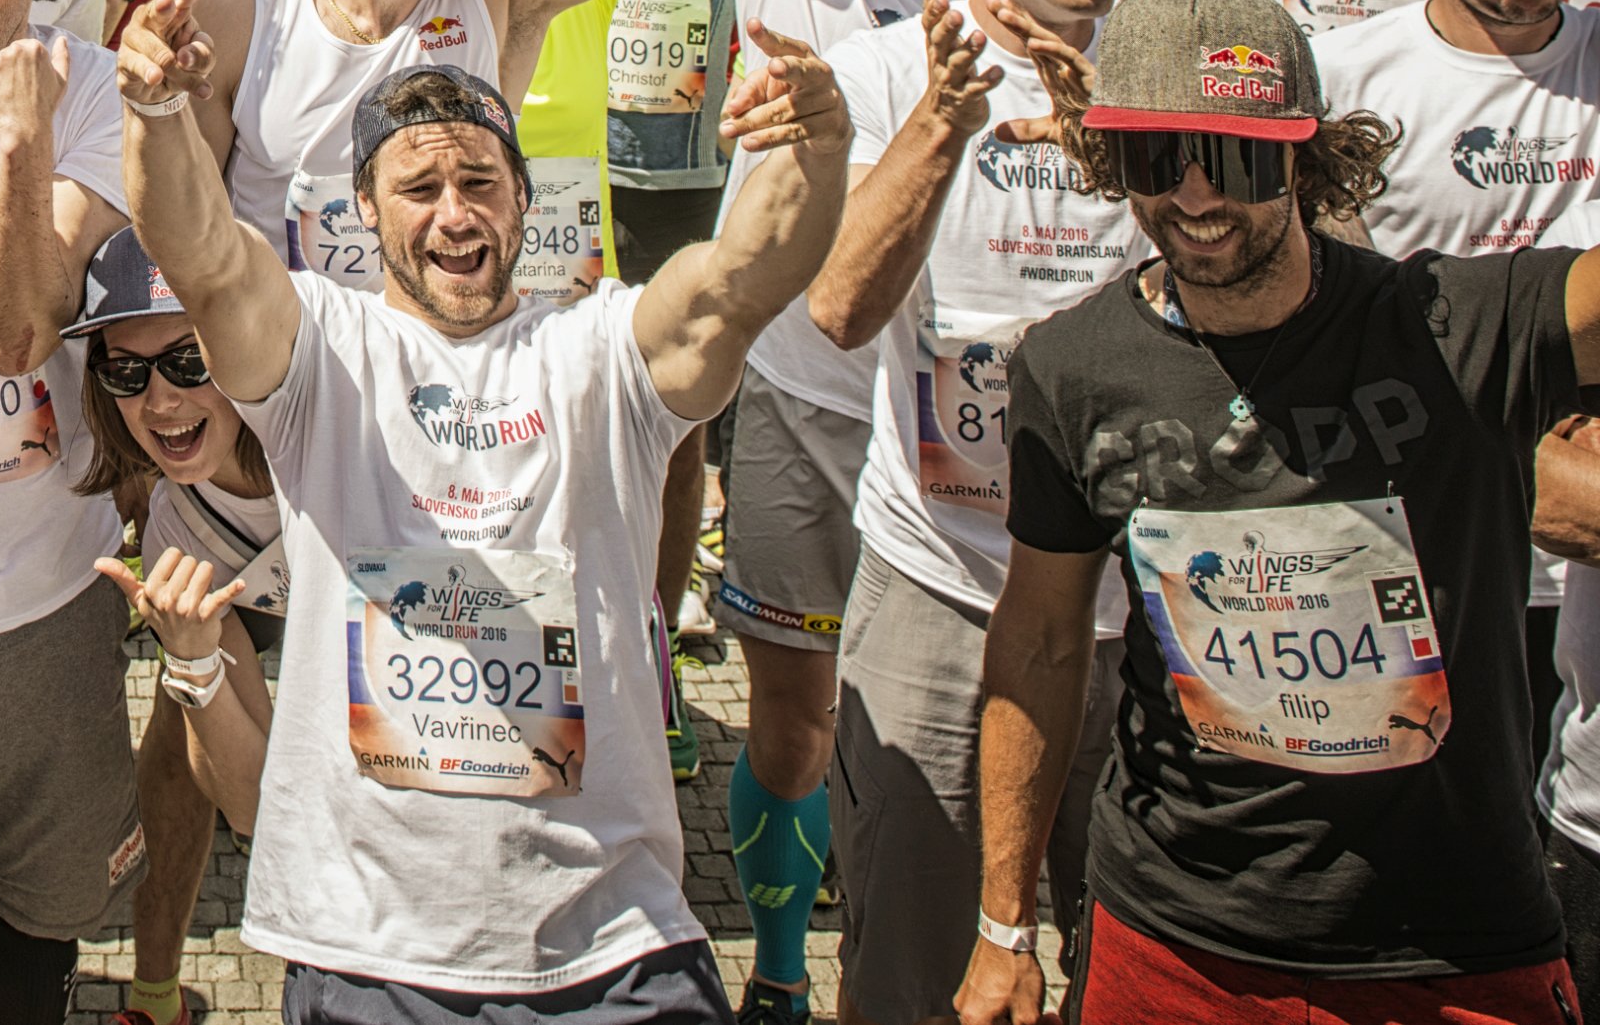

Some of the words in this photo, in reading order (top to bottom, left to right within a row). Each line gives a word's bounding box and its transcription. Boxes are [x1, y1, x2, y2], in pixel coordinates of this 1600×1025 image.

[623, 0, 666, 13] WINGS
[419, 36, 443, 52] Red
[444, 31, 467, 48] Bull
[610, 37, 685, 69] 0919
[609, 68, 668, 87] Christof
[1202, 74, 1247, 99] Red
[1247, 77, 1284, 104] Bull
[621, 93, 672, 104] BFGoodrich
[1497, 138, 1547, 152] WINGS
[1022, 225, 1033, 238] 8.
[1060, 227, 1089, 241] 2016
[1470, 233, 1531, 247] SLOVENSKO
[988, 238, 1053, 256] SLOVENSKO
[1056, 244, 1125, 259] BRATISLAVA
[1019, 266, 1094, 283] #WORLDRUN
[518, 286, 573, 297] BFGoodrich
[448, 484, 457, 500] 8.
[461, 487, 484, 505] MÁJ
[487, 488, 512, 504] 2016
[929, 482, 1002, 500] GARMIN
[412, 494, 478, 520] SLOVENSKO
[440, 524, 512, 542] #WORLDRUN
[1136, 526, 1170, 539] SLOVAKIA
[357, 562, 386, 573] SLOVAKIA
[1228, 553, 1314, 576] WINGS
[1228, 576, 1245, 585] FOR
[1246, 575, 1294, 594] LIFE
[431, 586, 503, 607] WINGS
[1298, 593, 1330, 610] 2016
[426, 605, 441, 613] FOR
[441, 606, 482, 623] LIFE
[722, 588, 804, 627] SALOMON
[481, 626, 507, 642] 2016
[1204, 623, 1387, 682] 41504
[387, 653, 543, 709] 32992
[1278, 692, 1331, 725] filip
[412, 713, 521, 743] Vavřinec
[1197, 721, 1277, 749] GARMIN
[1285, 735, 1390, 752] BFGoodrich
[360, 753, 430, 771] GARMIN
[439, 758, 530, 776] BFGoodrich
